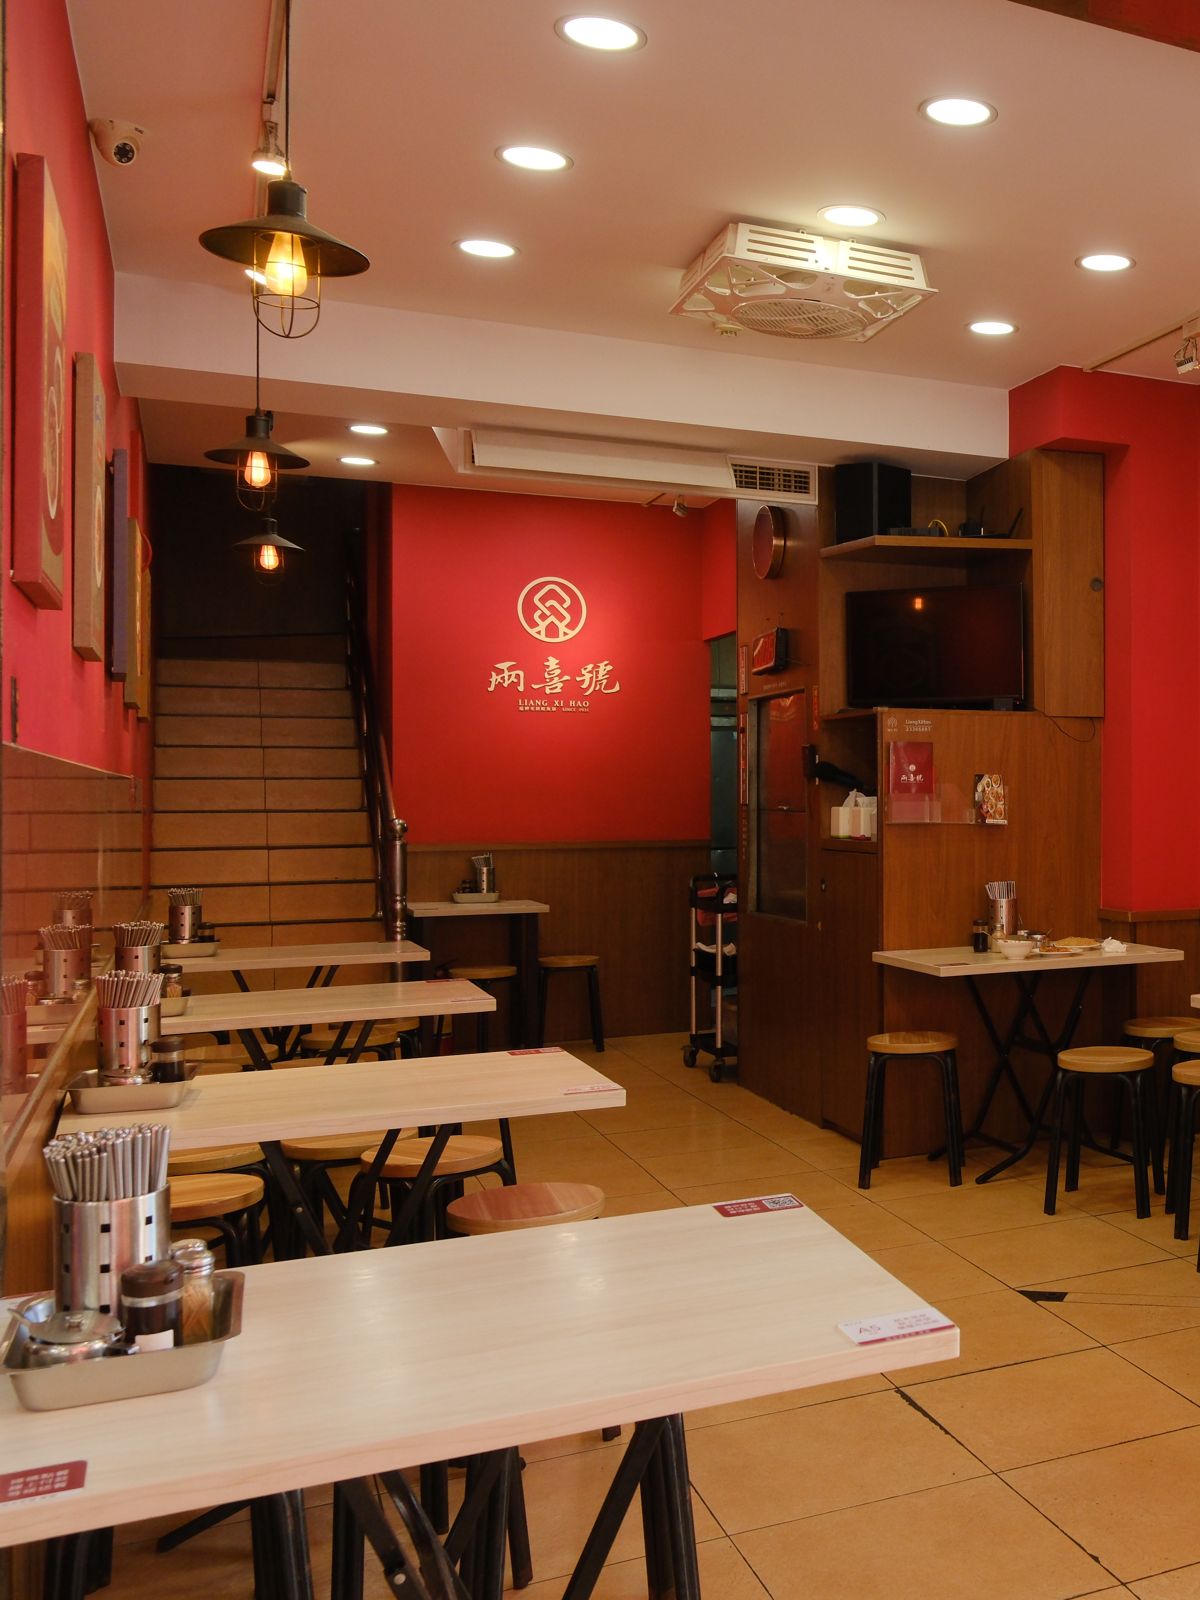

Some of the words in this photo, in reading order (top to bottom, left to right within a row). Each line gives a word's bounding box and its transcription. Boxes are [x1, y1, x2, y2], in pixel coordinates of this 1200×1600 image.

[487, 656, 621, 696] 兩喜號
[518, 699, 549, 707] LIANG
